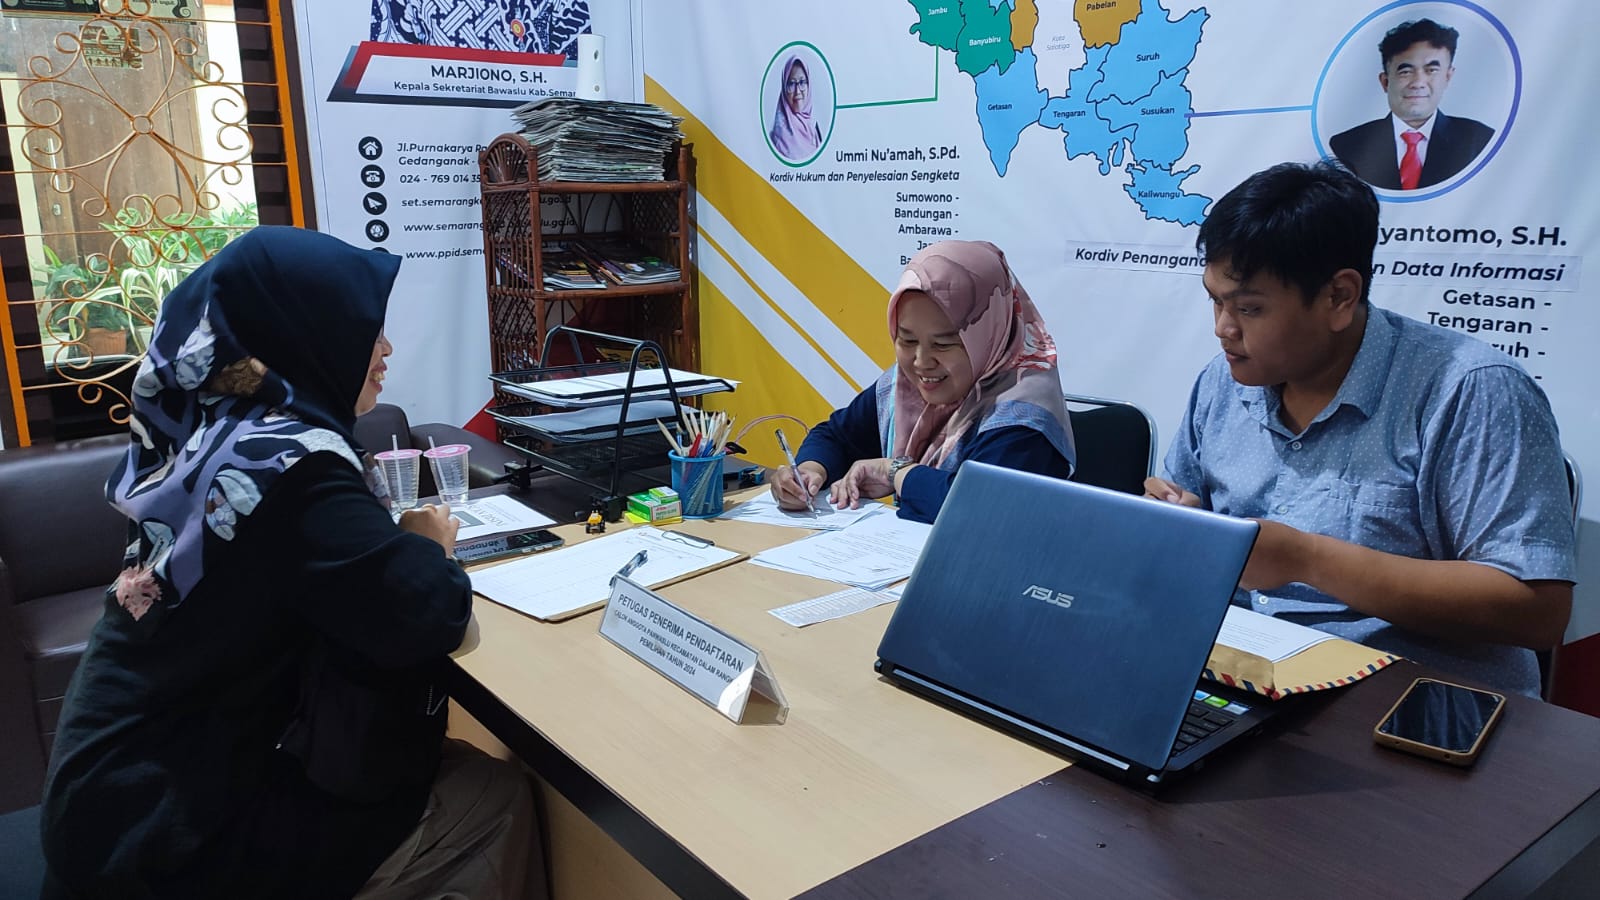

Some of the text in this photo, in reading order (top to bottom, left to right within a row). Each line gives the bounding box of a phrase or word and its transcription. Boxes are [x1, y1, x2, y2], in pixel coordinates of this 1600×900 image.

[927, 7, 948, 16] Jambu
[1086, 1, 1117, 11] Pabelan
[969, 36, 1001, 47] Banyubiru
[1136, 53, 1160, 62] Suruh
[431, 65, 547, 84] MARJIONO, S.H.
[394, 81, 577, 97] Kepala Sekretariat Bawaslu Kab.Semar
[988, 103, 1012, 111] Getasan
[1141, 107, 1175, 115] Susukan
[1053, 110, 1086, 119] Tengaran
[397, 143, 473, 154] Jl.Purnakarya
[836, 150, 868, 162] Ummi
[929, 146, 960, 160] S.Pd.
[398, 156, 470, 168] Gedanganak
[400, 174, 420, 183] 024
[431, 174, 450, 183] 769
[453, 174, 469, 183] 014
[770, 170, 960, 184] Kordiv Hukum dan Penyelesaian Sengketa
[896, 192, 952, 203] Sumowono
[1138, 190, 1180, 199] Kaliwungu
[894, 208, 952, 221] Bandungan
[898, 224, 952, 235] Ambarawa
[1379, 226, 1567, 248] yantomo, S.H.
[1075, 248, 1119, 263] Kordiv
[1391, 261, 1444, 277] Data
[1450, 262, 1566, 281] Informasi
[1443, 289, 1535, 309] Getasan
[1428, 312, 1532, 334] Tengaran
[1022, 585, 1075, 608] ASUS
[618, 594, 744, 673] PETUGAS PENERIMA PENDAFTARAN
[627, 617, 647, 632] ANGGOTA
[671, 643, 699, 664] KECAMATAN
[698, 659, 716, 674] DALAM
[666, 652, 684, 668] TAHUN
[683, 663, 696, 675] 2024
